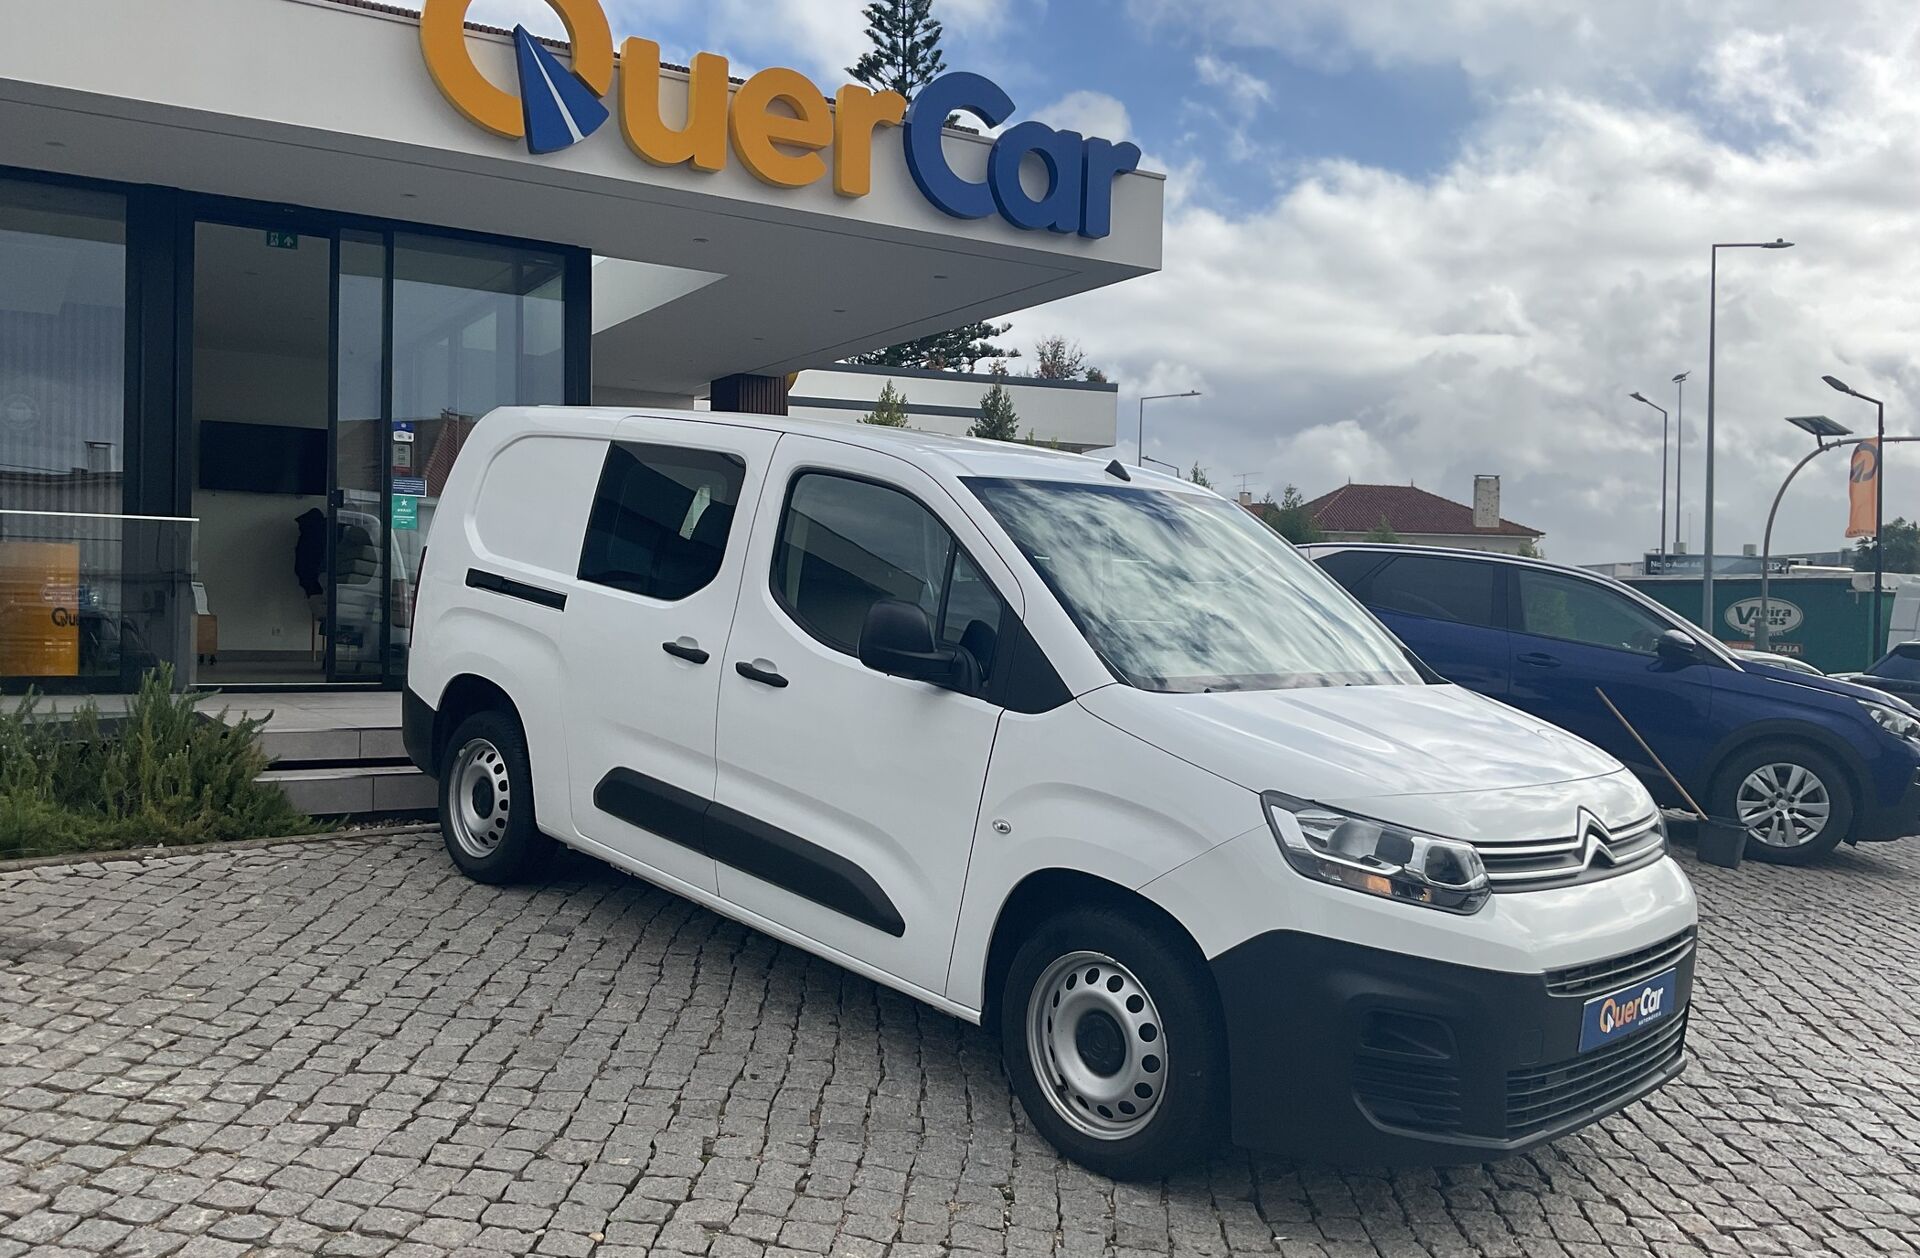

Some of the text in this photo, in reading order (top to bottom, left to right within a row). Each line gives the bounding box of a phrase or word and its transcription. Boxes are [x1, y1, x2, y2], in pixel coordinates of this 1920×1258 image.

[420, 0, 1141, 239] QuerCar
[1650, 560, 1671, 568] Noo
[1735, 606, 1792, 625] Viira
[1600, 987, 1664, 1034] QuerCar
